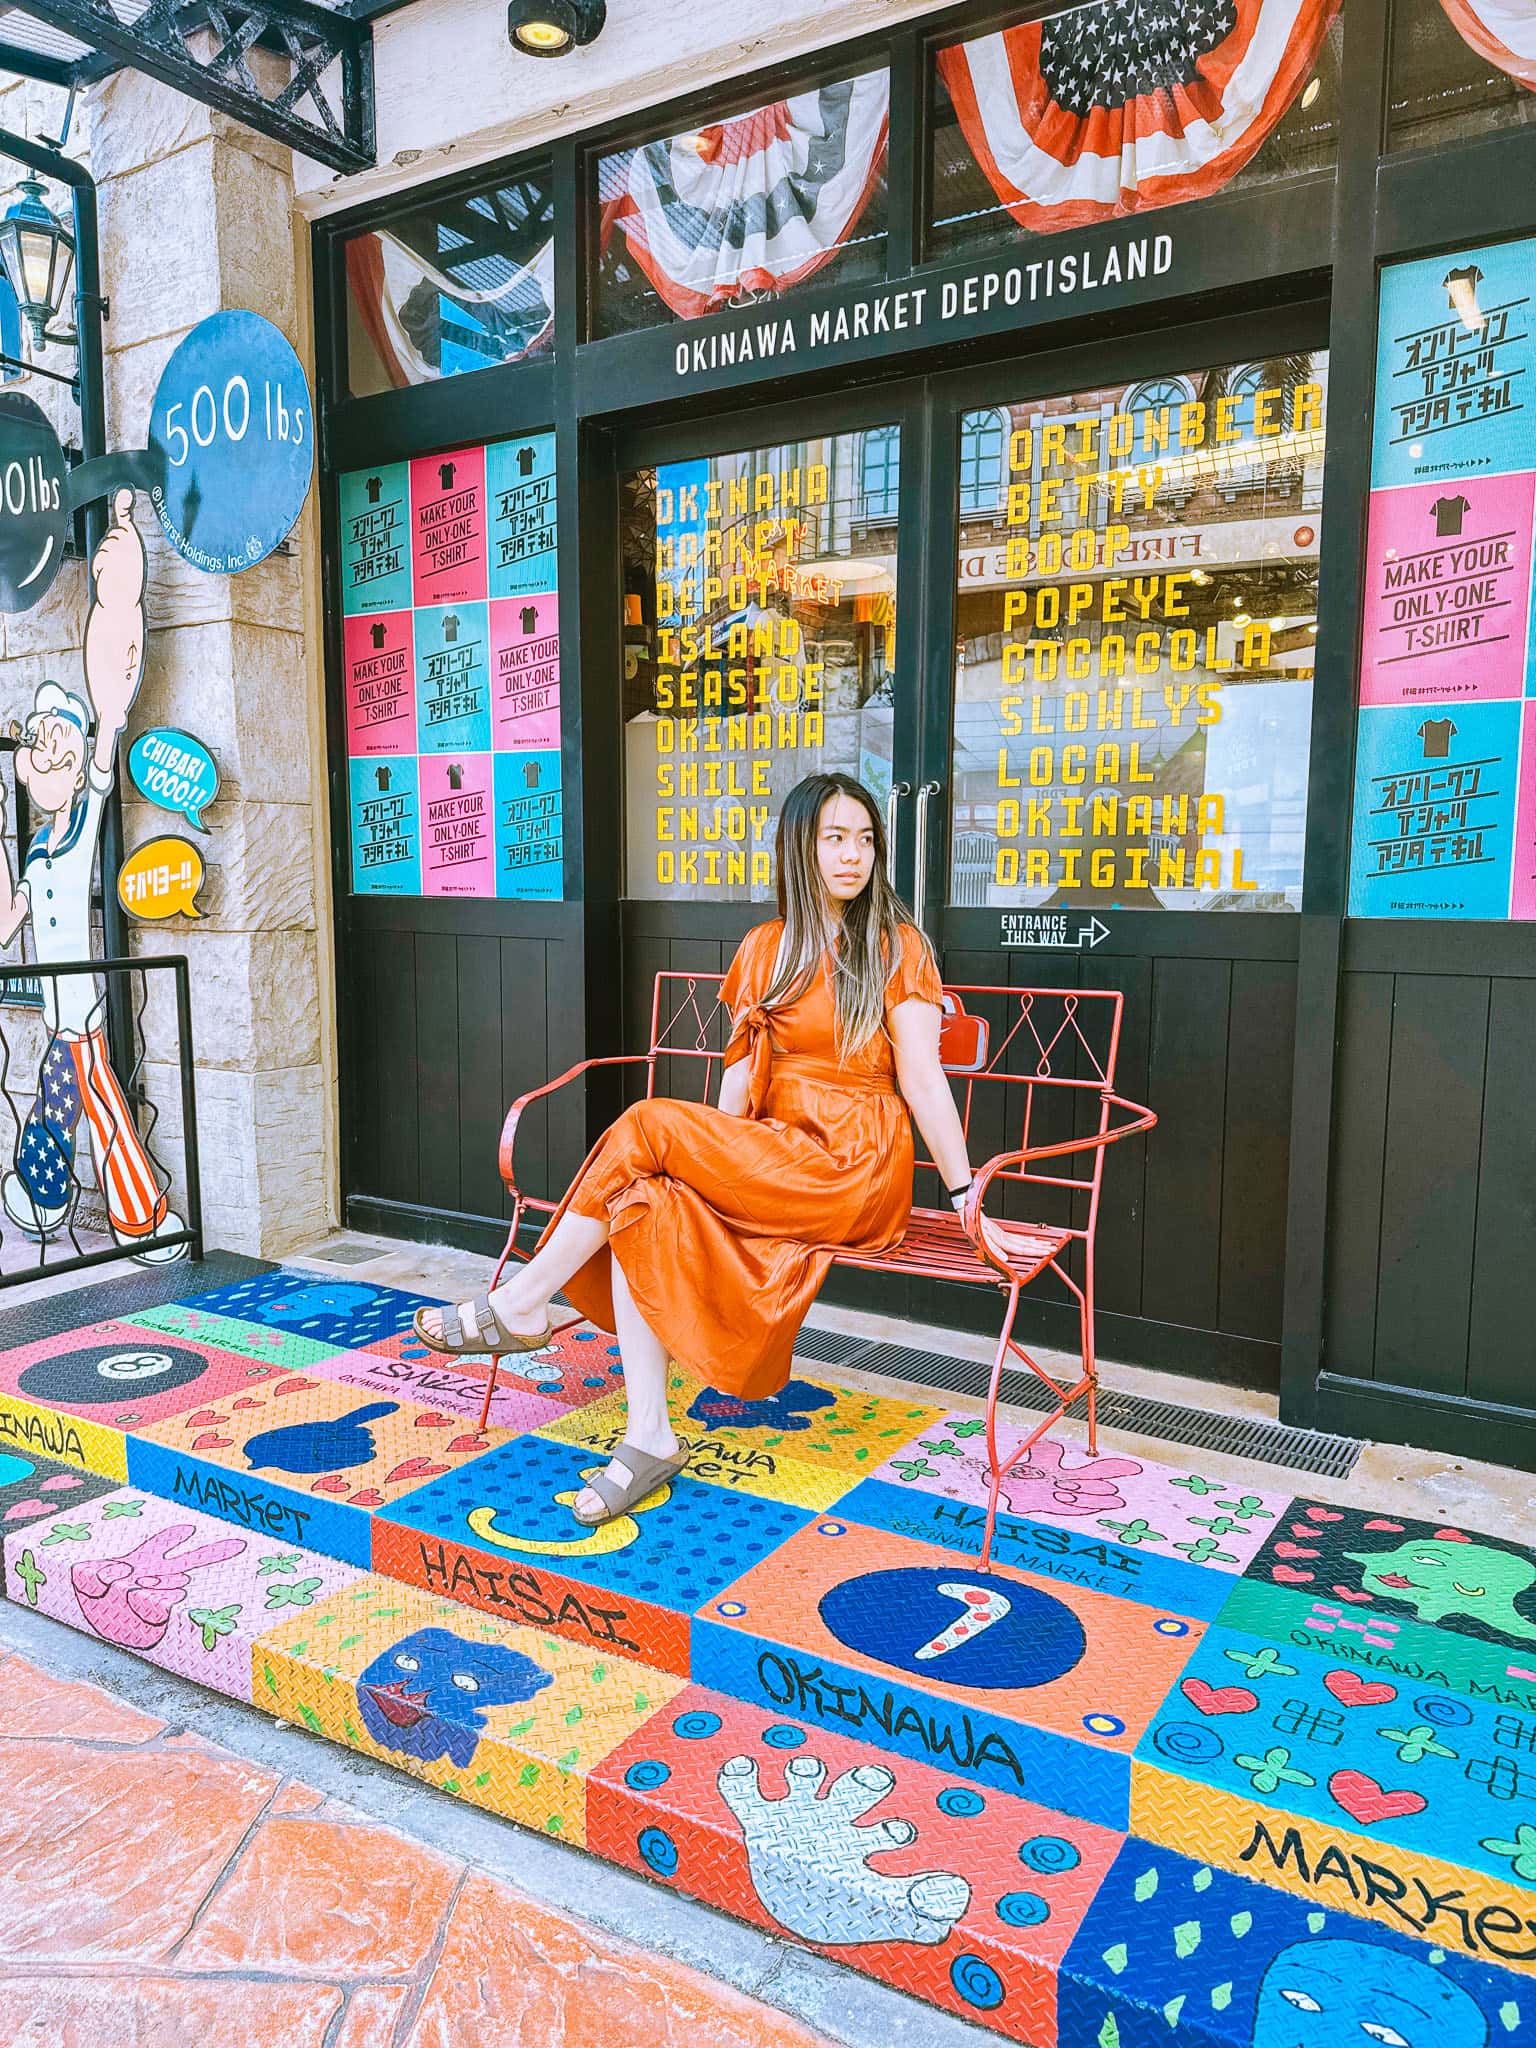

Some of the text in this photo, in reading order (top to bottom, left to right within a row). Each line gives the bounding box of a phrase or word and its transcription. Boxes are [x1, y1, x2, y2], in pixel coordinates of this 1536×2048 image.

[675, 234, 1173, 376] OKINAWA MARKET DEPOTISLAND
[166, 375, 304, 466] 500 lbs
[1009, 383, 1323, 471] ORIONBEER
[420, 493, 476, 526] MAKE YOUR
[656, 464, 828, 525] OKINAWA
[1007, 466, 1163, 525] BETTY
[180, 538, 225, 571] Holdings,
[228, 555, 247, 568] Inc.
[425, 519, 472, 549] ONLY-ONE
[656, 518, 798, 572] MARKET
[1006, 524, 1130, 580] BOOP
[432, 543, 468, 569] T-SHIRT
[1384, 541, 1508, 589] MAKE YOUR
[656, 571, 769, 618] DEPOT
[1004, 573, 1190, 632] POPEYE
[1393, 578, 1498, 622] ONLY-ONE
[657, 618, 800, 663] ISLAND
[1003, 624, 1272, 684] COCACOLA
[1405, 614, 1485, 651] T-SHIRT
[353, 653, 405, 681] MAKE YOUR
[500, 641, 559, 671] MAKE YOUR
[359, 678, 402, 703] ONLY-ONE
[505, 665, 555, 693] ONLY-ONE
[657, 663, 825, 708] SEASIDE
[365, 700, 398, 721] T-SHIRT
[512, 690, 550, 714] T-SHIRT
[657, 711, 824, 753] OKINAWA
[142, 735, 207, 780] CHIBARI
[657, 760, 771, 797] SMILE
[998, 742, 1154, 788] LOCAL
[142, 767, 205, 810] YOOO!!
[429, 797, 484, 821] MAKE YOUR
[434, 820, 480, 843] ONLY-ONE
[657, 806, 768, 841] ENJOY
[997, 794, 1225, 838] OKINAWA
[440, 842, 476, 862] T-SHIRT
[657, 850, 770, 885] OKINA
[995, 848, 1258, 890] ORIGINAL
[1001, 915, 1067, 931] ENTRANCE
[1007, 930, 1066, 945] THIS WAY
[934, 1505, 1142, 1575] HAISAI
[1014, 1552, 1140, 1595] MARKET
[419, 1542, 641, 1652] HAISAI
[1290, 1629, 1451, 1688] OKINAWA
[757, 1652, 1025, 1787] OKINAWA
[1240, 1821, 1536, 1960] MARKe
